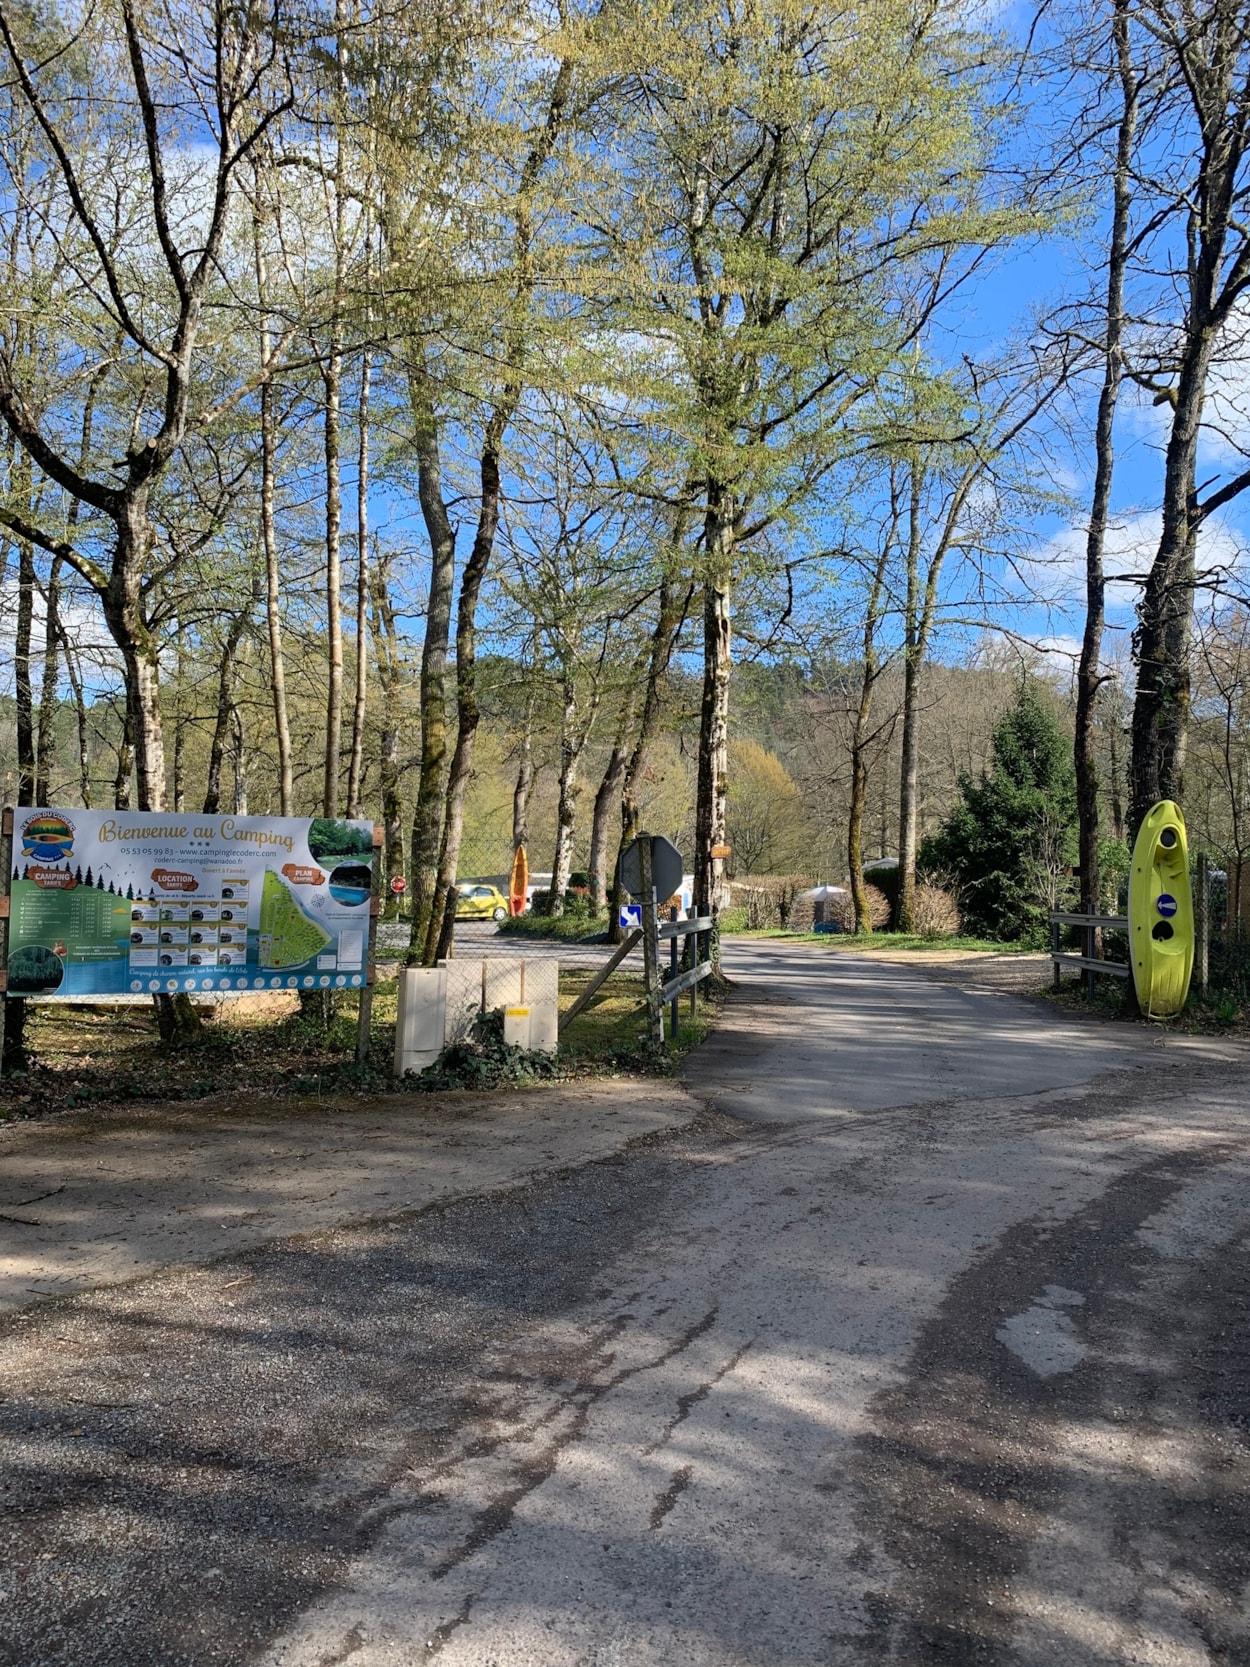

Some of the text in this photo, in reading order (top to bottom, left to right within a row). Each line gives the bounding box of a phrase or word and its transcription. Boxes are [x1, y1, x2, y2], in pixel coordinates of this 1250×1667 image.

[98, 819, 295, 853] Bienvenue au Camping
[120, 847, 131, 855] 05
[132, 847, 141, 855] 53
[153, 848, 163, 856] 99
[164, 848, 174, 856] 83
[180, 849, 277, 857] www.campinglecoderc.com
[154, 857, 243, 865] coderc-camping@wanadoo.fr
[295, 869, 313, 877] PLAN
[158, 875, 193, 883] LOCATION
